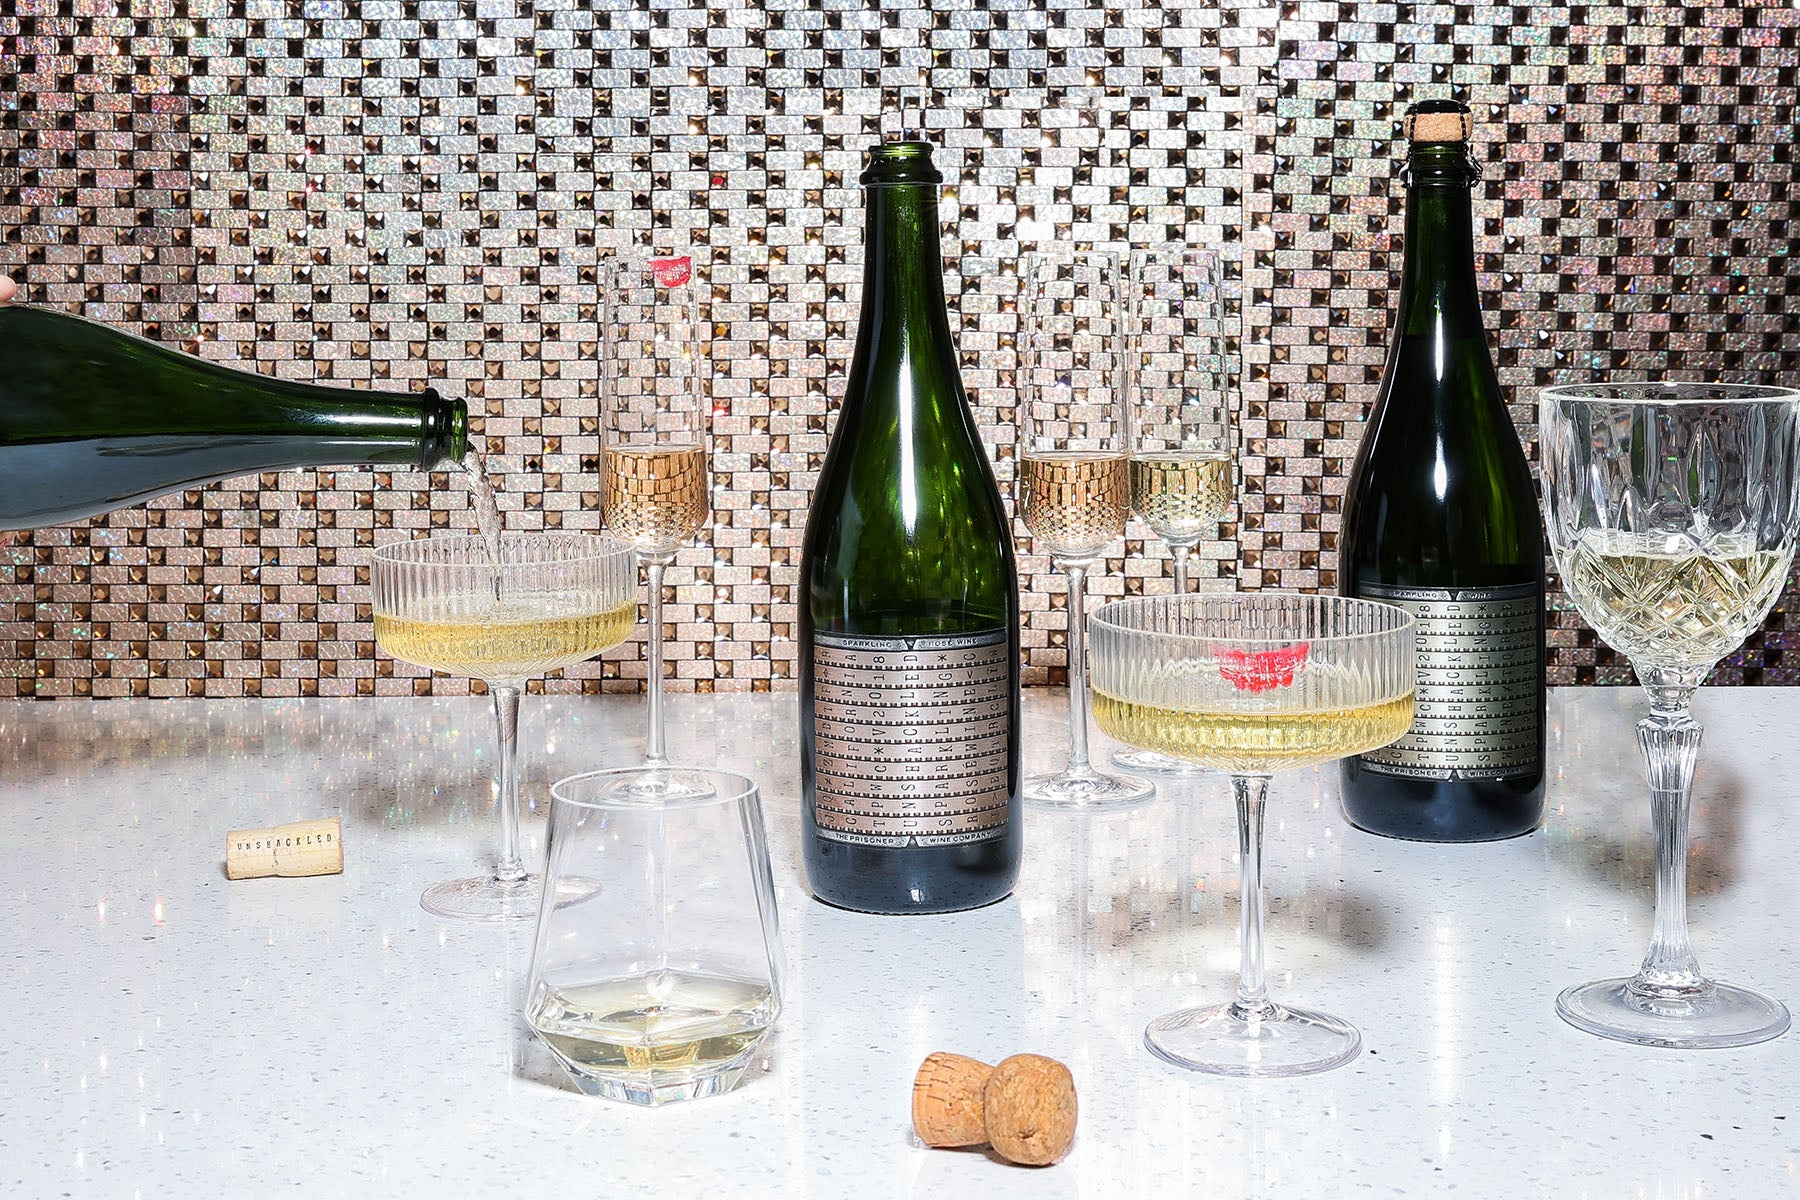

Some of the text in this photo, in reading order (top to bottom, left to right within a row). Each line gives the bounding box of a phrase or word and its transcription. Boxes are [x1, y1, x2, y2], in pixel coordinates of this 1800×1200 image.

[842, 639, 892, 648] SPARKLING
[957, 637, 977, 646] WINE
[1444, 604, 1464, 762] UNSHACKLED
[841, 653, 859, 825] CALIFORNIA
[901, 654, 922, 828] UNSHACKLED
[237, 833, 333, 851] UNSHACKLED
[848, 834, 895, 845] PRISONER
[929, 831, 992, 845] WINE COMPANY
